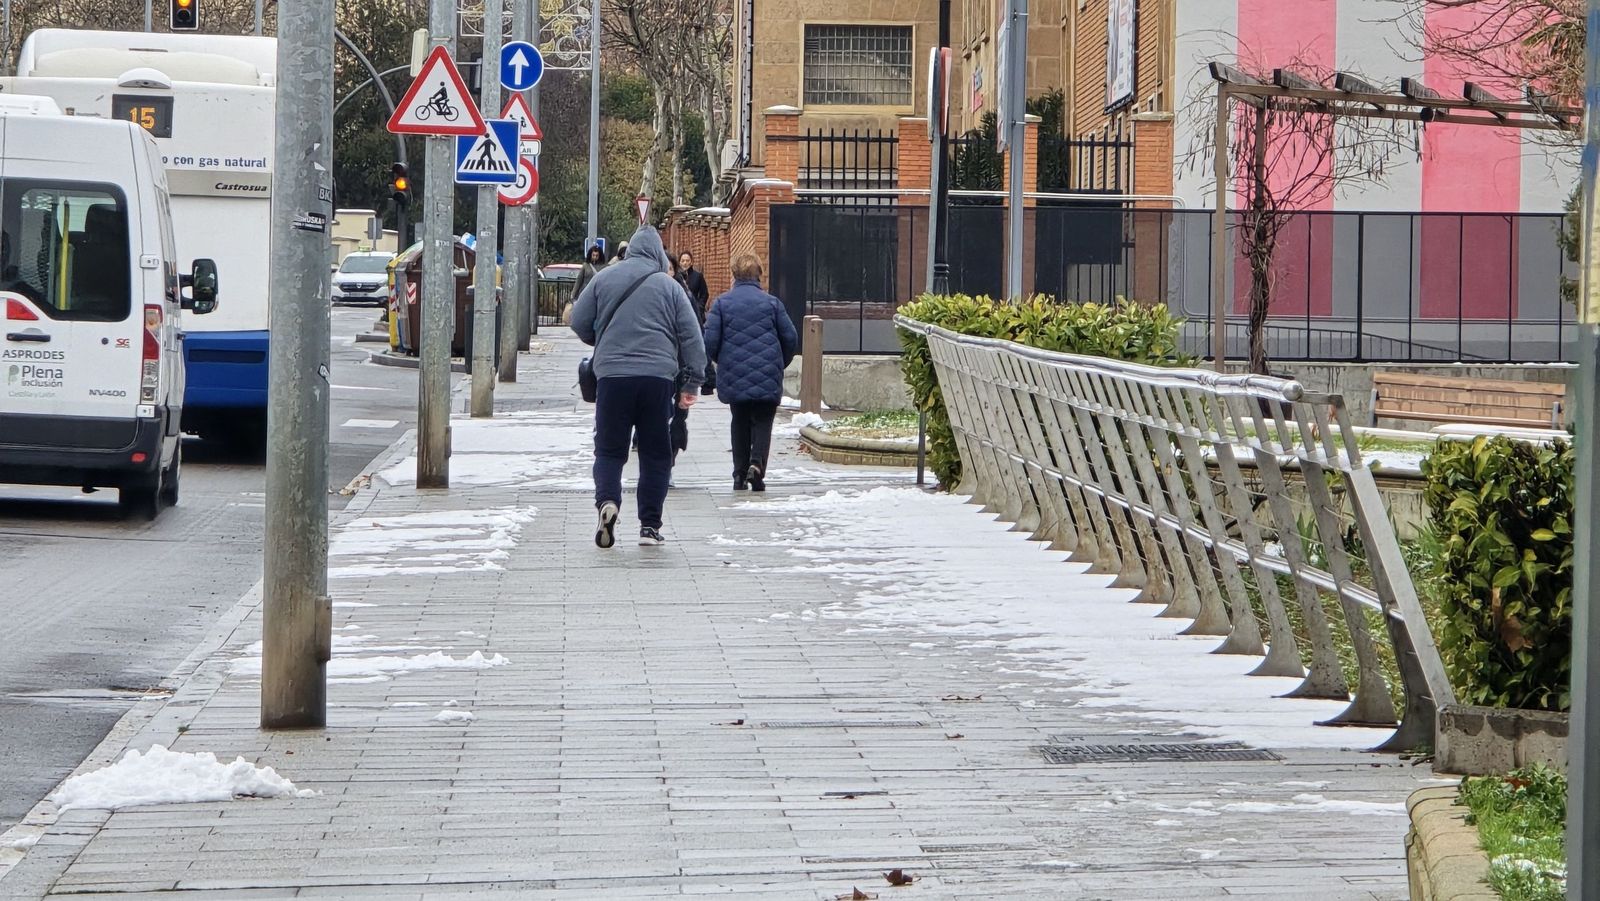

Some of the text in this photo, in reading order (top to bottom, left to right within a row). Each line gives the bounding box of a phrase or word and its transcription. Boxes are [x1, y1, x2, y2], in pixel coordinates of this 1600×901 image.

[130, 107, 156, 129] 15
[173, 156, 194, 165] con
[199, 157, 219, 167] gas
[225, 157, 266, 168] natural
[215, 182, 267, 192] Castrosua
[2, 349, 65, 360] ASPRODES
[22, 365, 63, 379] Plena
